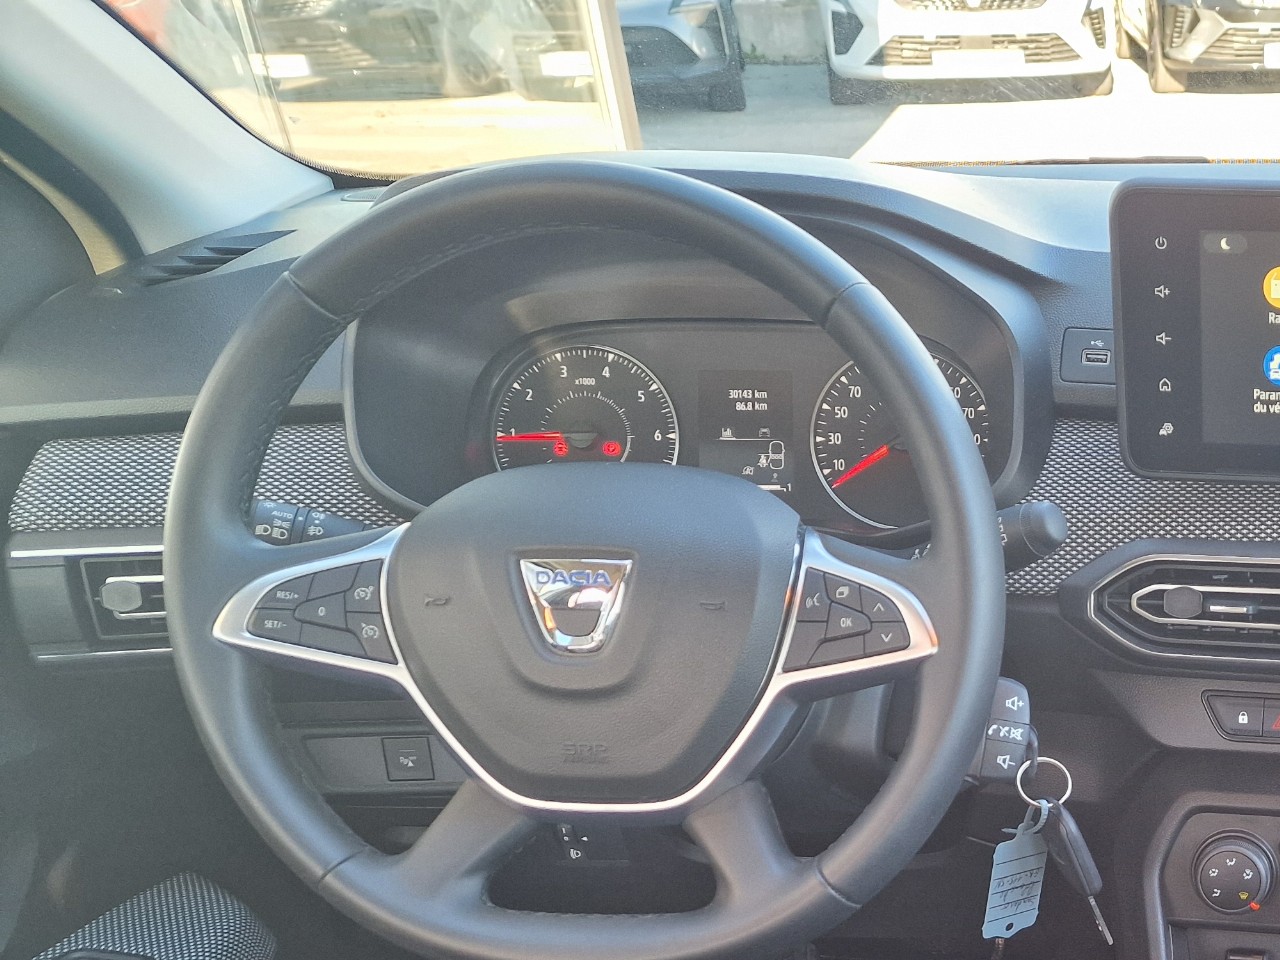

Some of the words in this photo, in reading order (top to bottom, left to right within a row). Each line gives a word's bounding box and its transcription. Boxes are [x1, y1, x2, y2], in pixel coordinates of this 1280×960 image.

[560, 365, 568, 378] 3
[602, 366, 611, 378] 4
[575, 377, 596, 386] x1000
[525, 388, 533, 401] 2
[637, 390, 645, 402] 5
[728, 390, 752, 399] 30143
[754, 390, 768, 399] km
[848, 385, 862, 398] 70
[735, 402, 752, 411] 86.8
[754, 402, 768, 411] km
[834, 406, 848, 419] 50
[1253, 402, 1267, 413] du
[509, 428, 516, 437] 1
[654, 429, 662, 441] 6
[828, 433, 842, 445] 30
[832, 459, 845, 471] 10
[271, 510, 293, 519] AUTO
[535, 570, 611, 586] DACIA
[840, 617, 852, 628] OK
